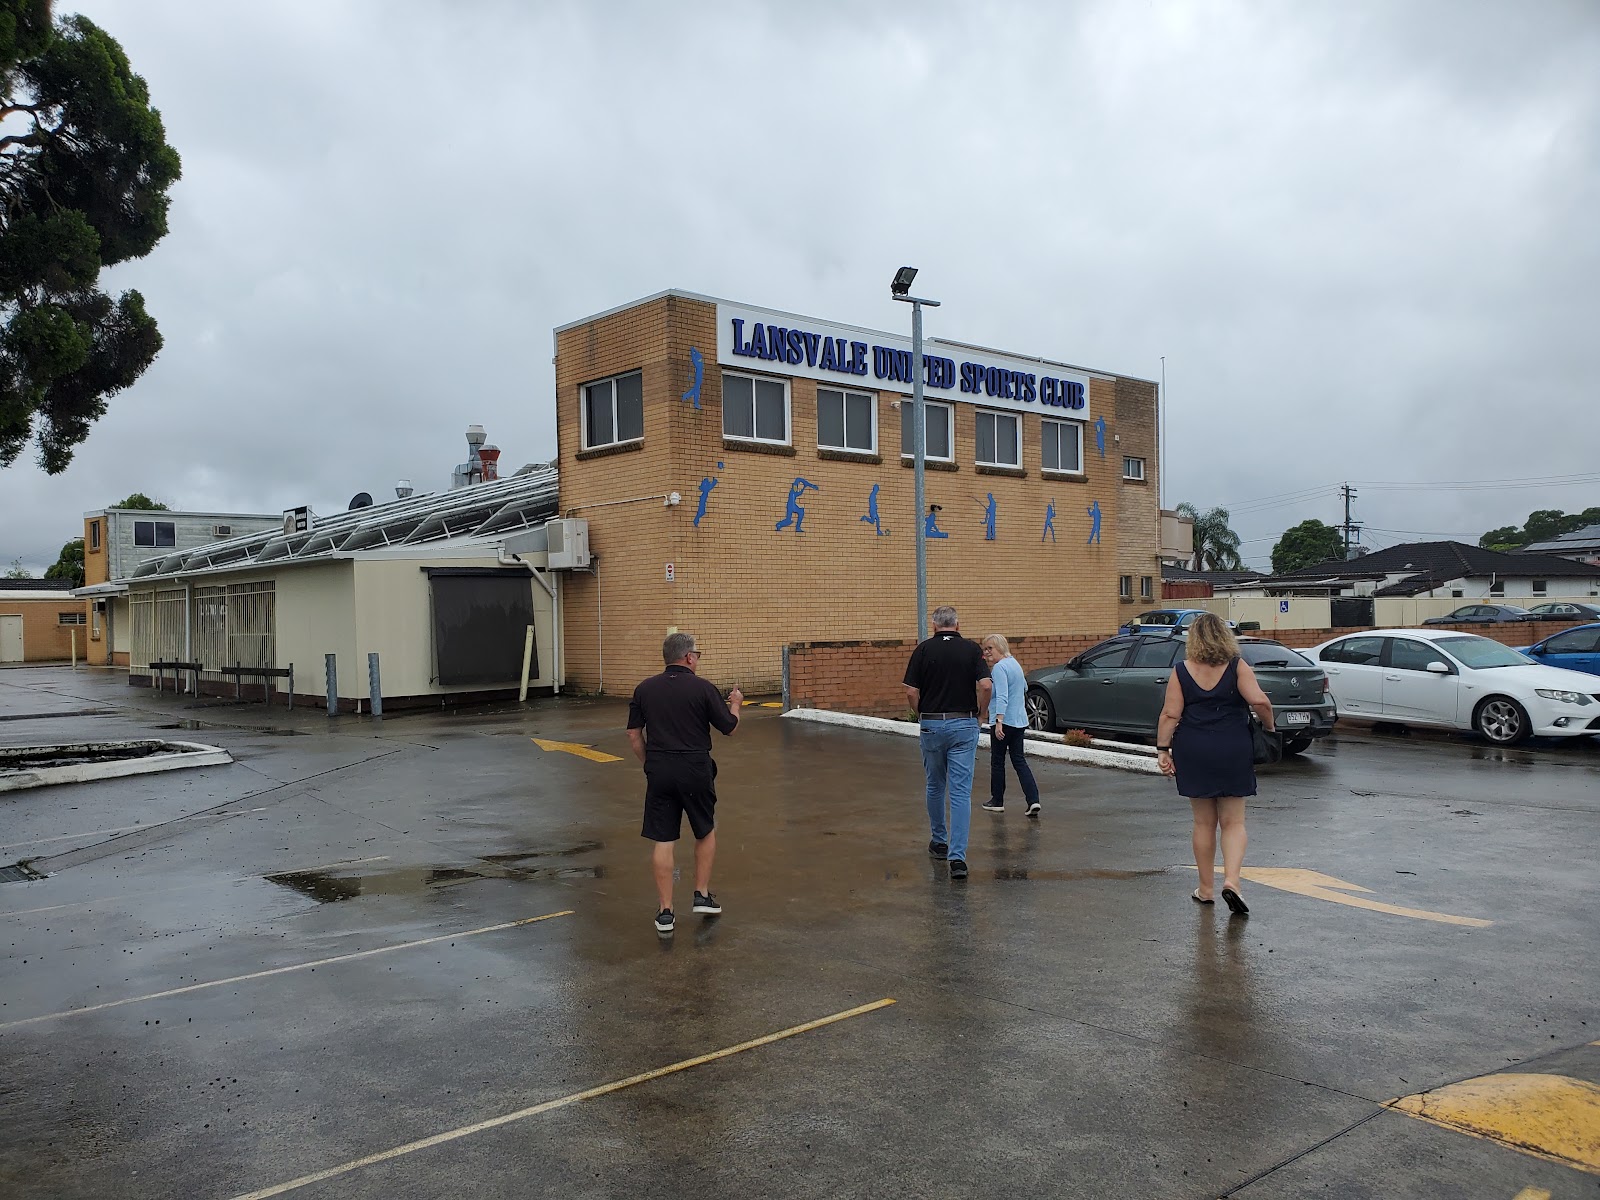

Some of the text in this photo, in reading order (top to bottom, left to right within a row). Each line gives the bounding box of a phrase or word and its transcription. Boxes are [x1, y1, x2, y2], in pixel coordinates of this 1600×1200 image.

[732, 318, 868, 376] LANSVALE
[960, 361, 1037, 403] SPORTS
[1040, 376, 1085, 410] CLUB
